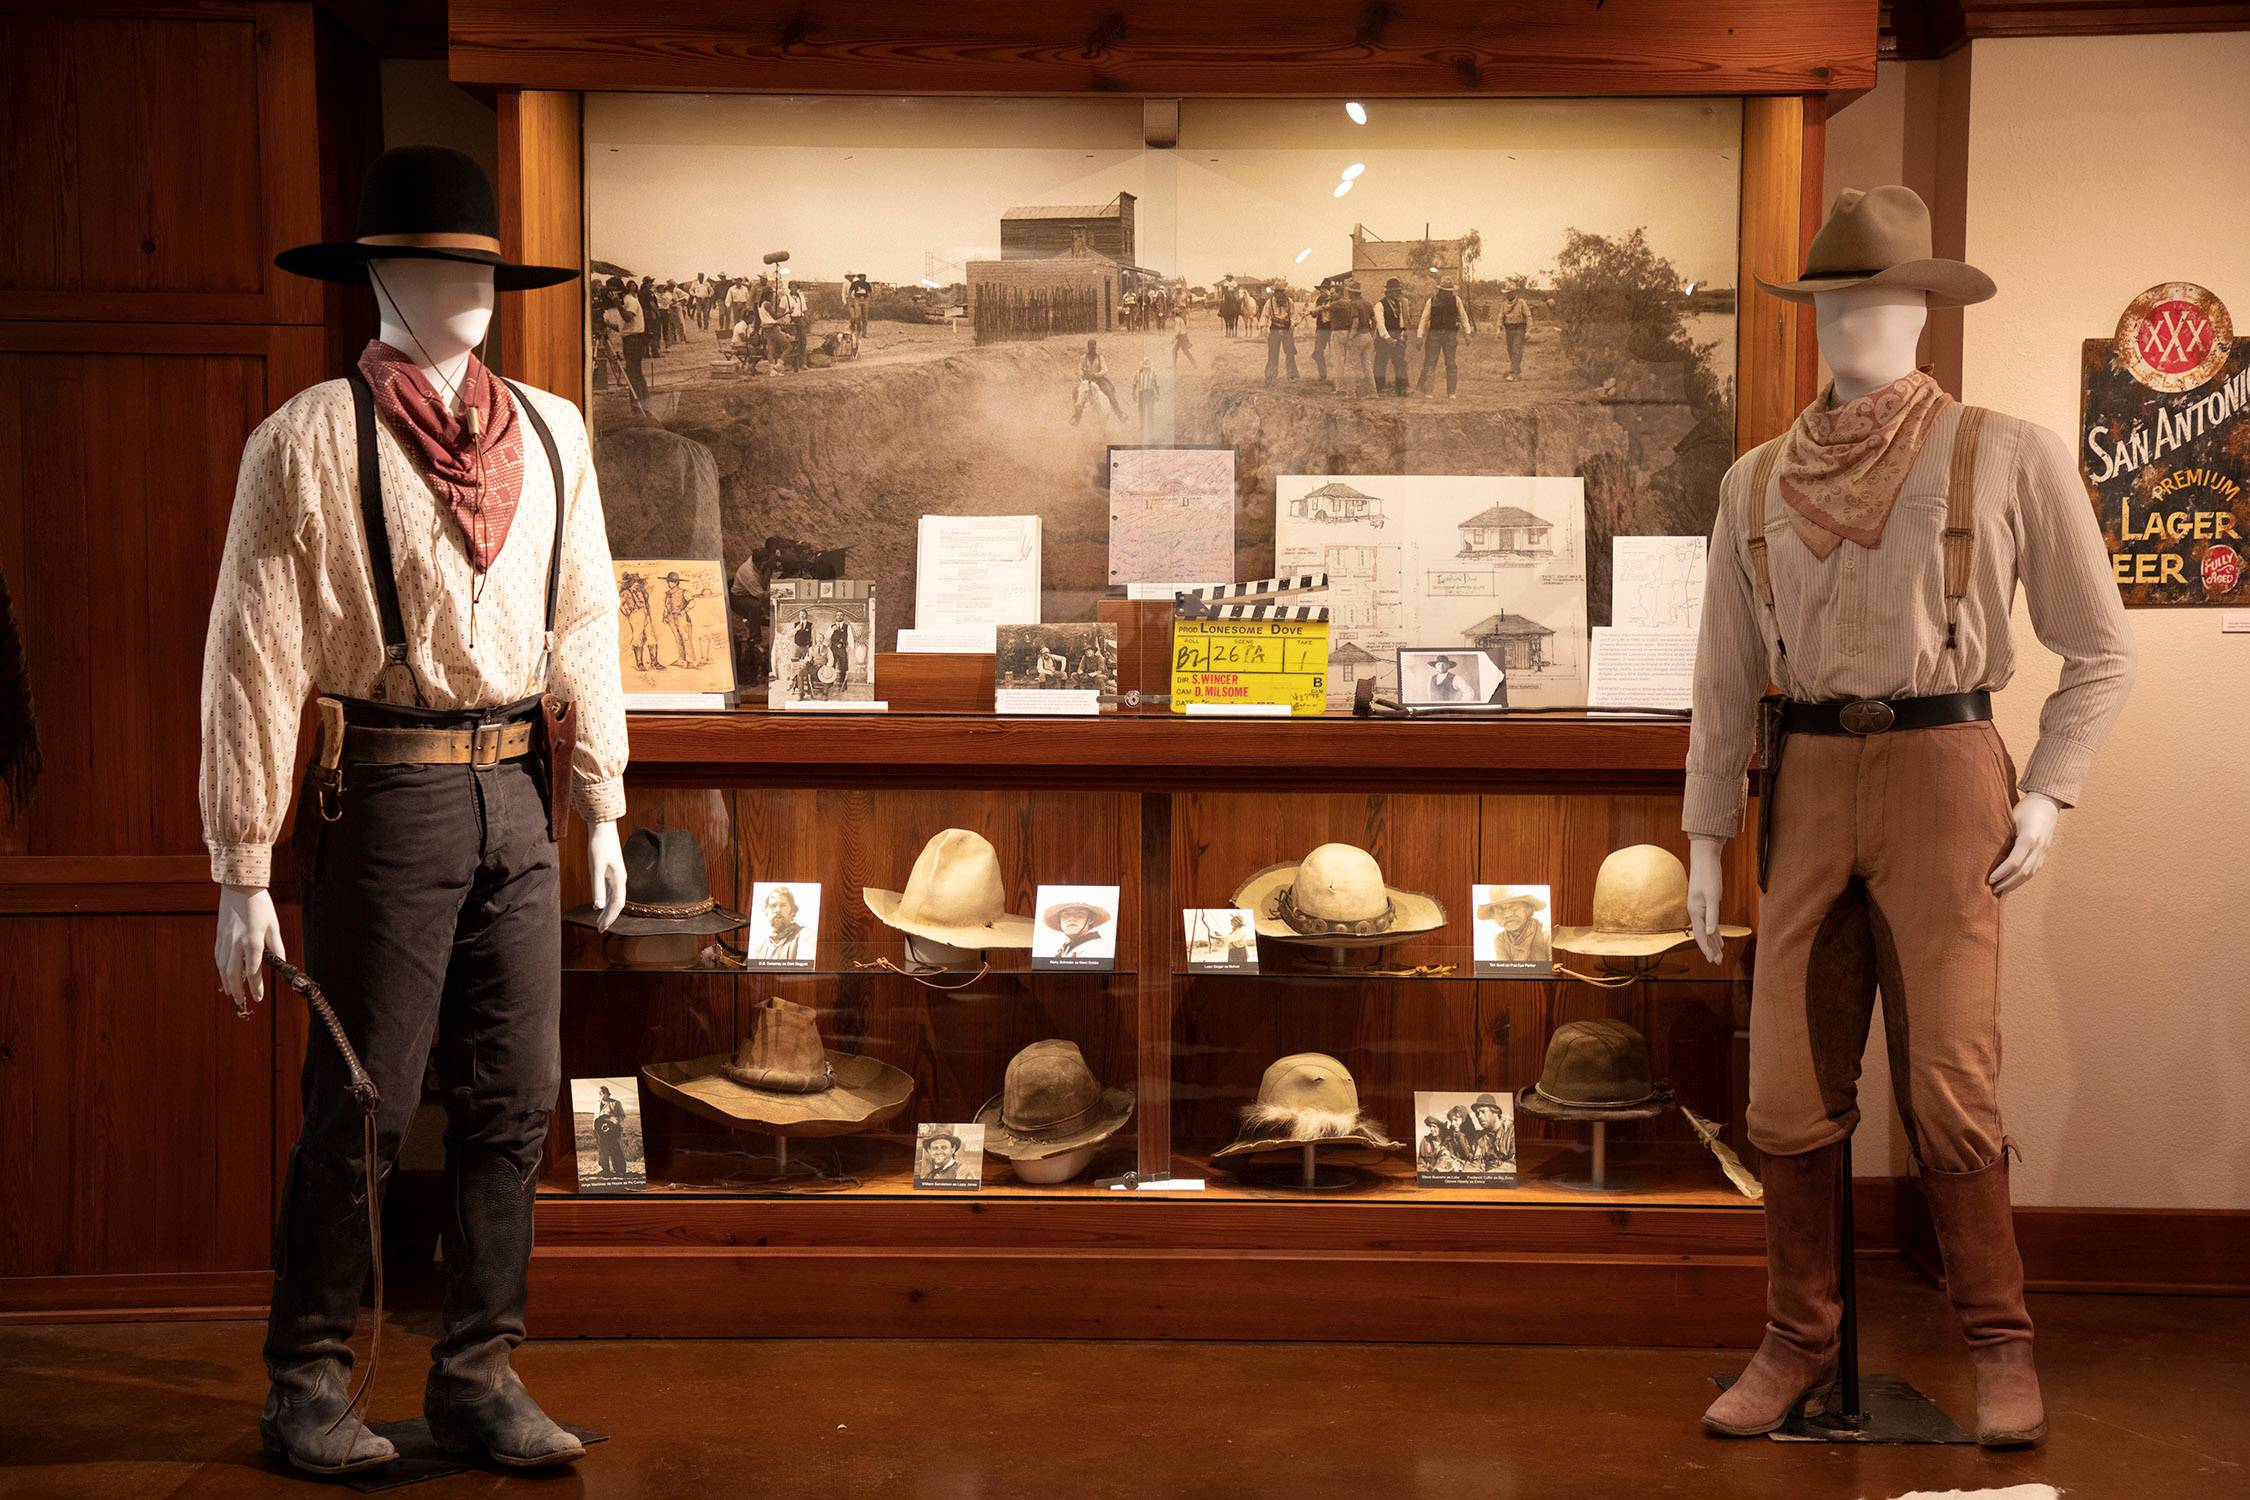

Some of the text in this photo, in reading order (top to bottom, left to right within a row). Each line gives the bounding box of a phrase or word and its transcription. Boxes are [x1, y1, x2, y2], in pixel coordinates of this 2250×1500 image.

[2143, 311, 2208, 362] XXX
[2153, 364, 2250, 461] ANTONI
[2152, 468, 2241, 501] PREMIUM
[2121, 497, 2241, 541] LAGER
[2112, 553, 2188, 584] EER
[2204, 553, 2234, 573] FULLY
[2206, 571, 2234, 584] AGED
[1200, 622, 1263, 635] LONESOME
[1271, 623, 1303, 635] DOVE
[1205, 686, 1249, 697] MILSOME
[1313, 677, 1323, 688] B
